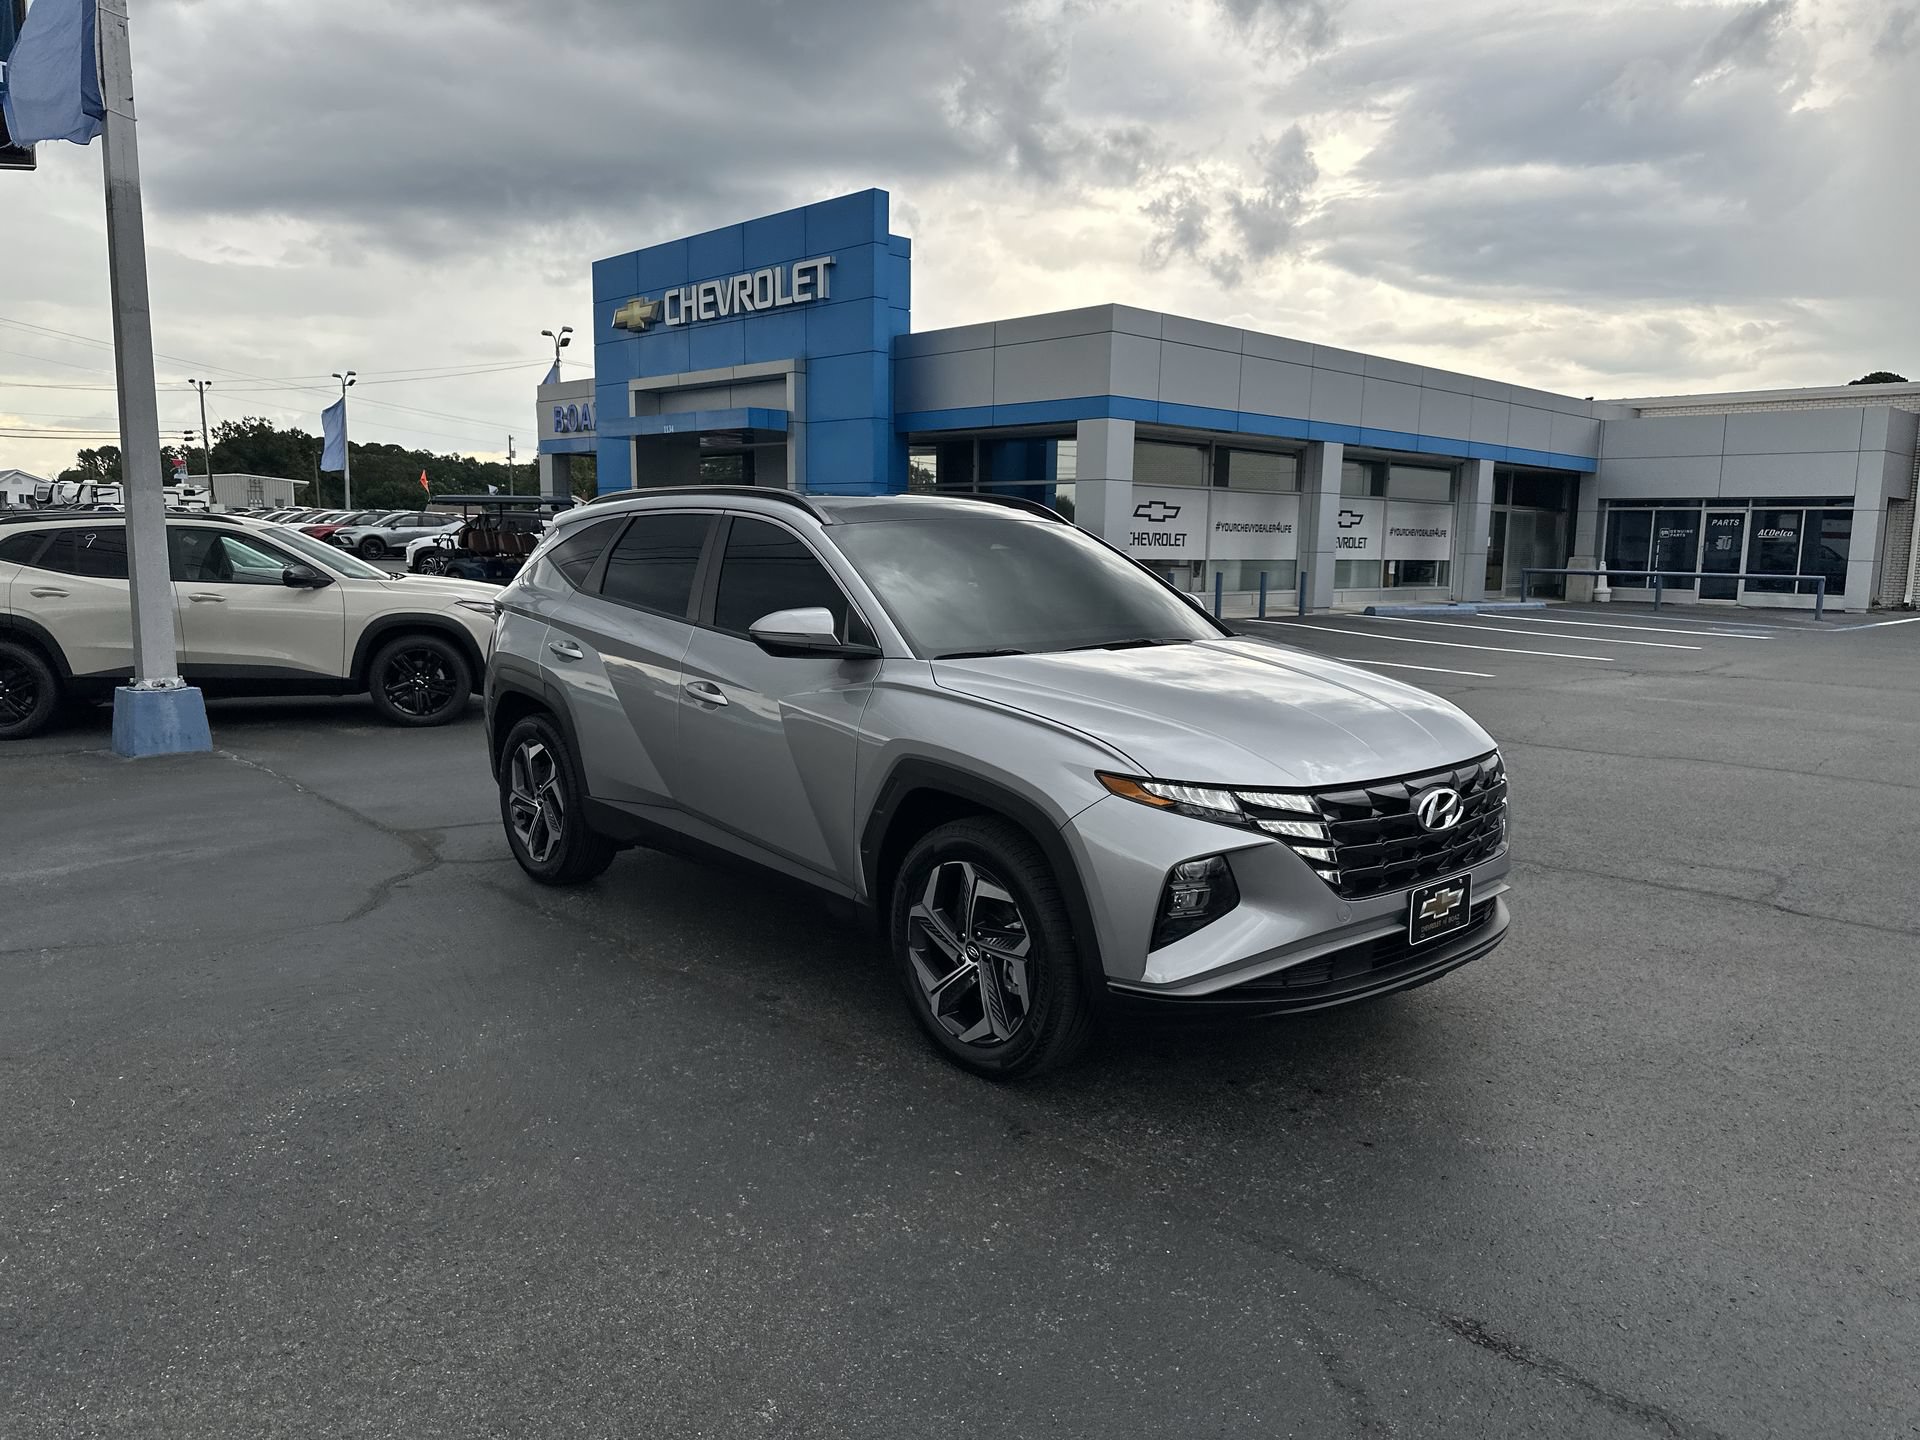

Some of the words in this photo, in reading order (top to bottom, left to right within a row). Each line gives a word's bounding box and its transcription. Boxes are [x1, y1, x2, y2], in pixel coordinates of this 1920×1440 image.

[663, 255, 836, 326] CHEVROLET
[553, 403, 597, 433] BOA
[1711, 518, 1740, 527] PARTS
[85, 533, 97, 549] 9
[1757, 529, 1794, 537] ACDelco
